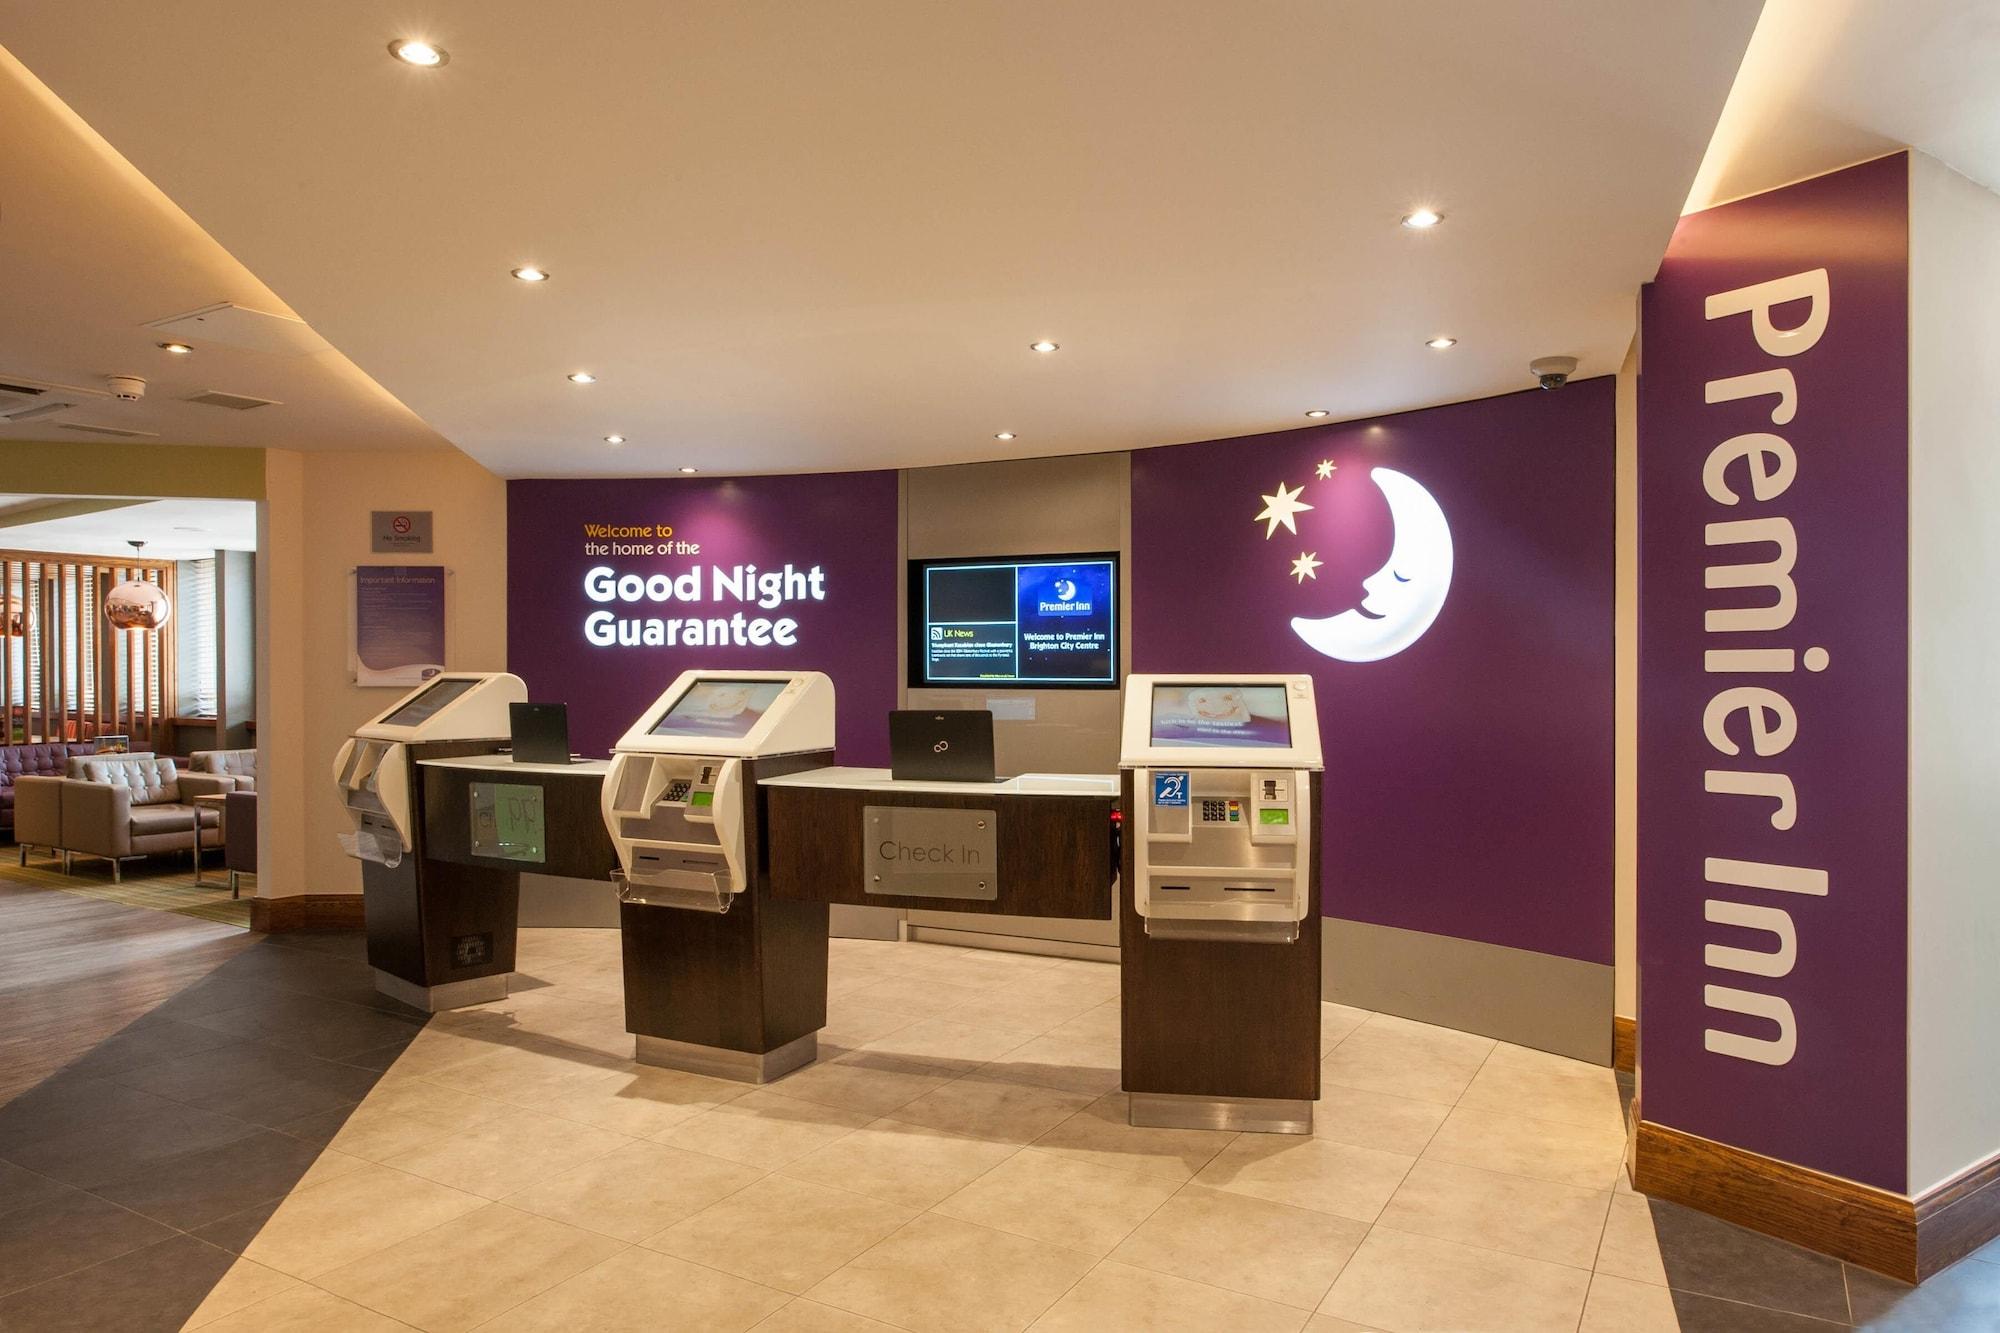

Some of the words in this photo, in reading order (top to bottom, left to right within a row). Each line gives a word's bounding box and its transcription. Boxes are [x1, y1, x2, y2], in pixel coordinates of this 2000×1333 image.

[584, 524, 652, 538] Welcome
[656, 524, 673, 537] to
[394, 535, 421, 543] Smoking
[584, 542, 609, 556] the
[612, 541, 654, 555] home
[657, 541, 674, 555] of
[676, 541, 701, 555] the
[1702, 267, 1831, 832] Premier
[360, 576, 395, 585] Important
[397, 576, 435, 584] Information
[584, 565, 702, 602] Good
[712, 564, 826, 609] Night
[1039, 601, 1075, 611] Premier
[1075, 601, 1091, 611] Inn
[584, 610, 799, 646] Guarantee
[943, 629, 954, 638] UK
[954, 629, 974, 638] News
[1023, 633, 1055, 641] Welcome
[1065, 632, 1093, 640] Premier
[1093, 632, 1105, 640] Inn
[1029, 641, 1059, 651] Brighton
[1060, 641, 1074, 651] City
[1075, 641, 1099, 650] Centre
[879, 840, 954, 863] Check
[962, 844, 980, 865] In
[1703, 856, 1830, 1066] Inn
